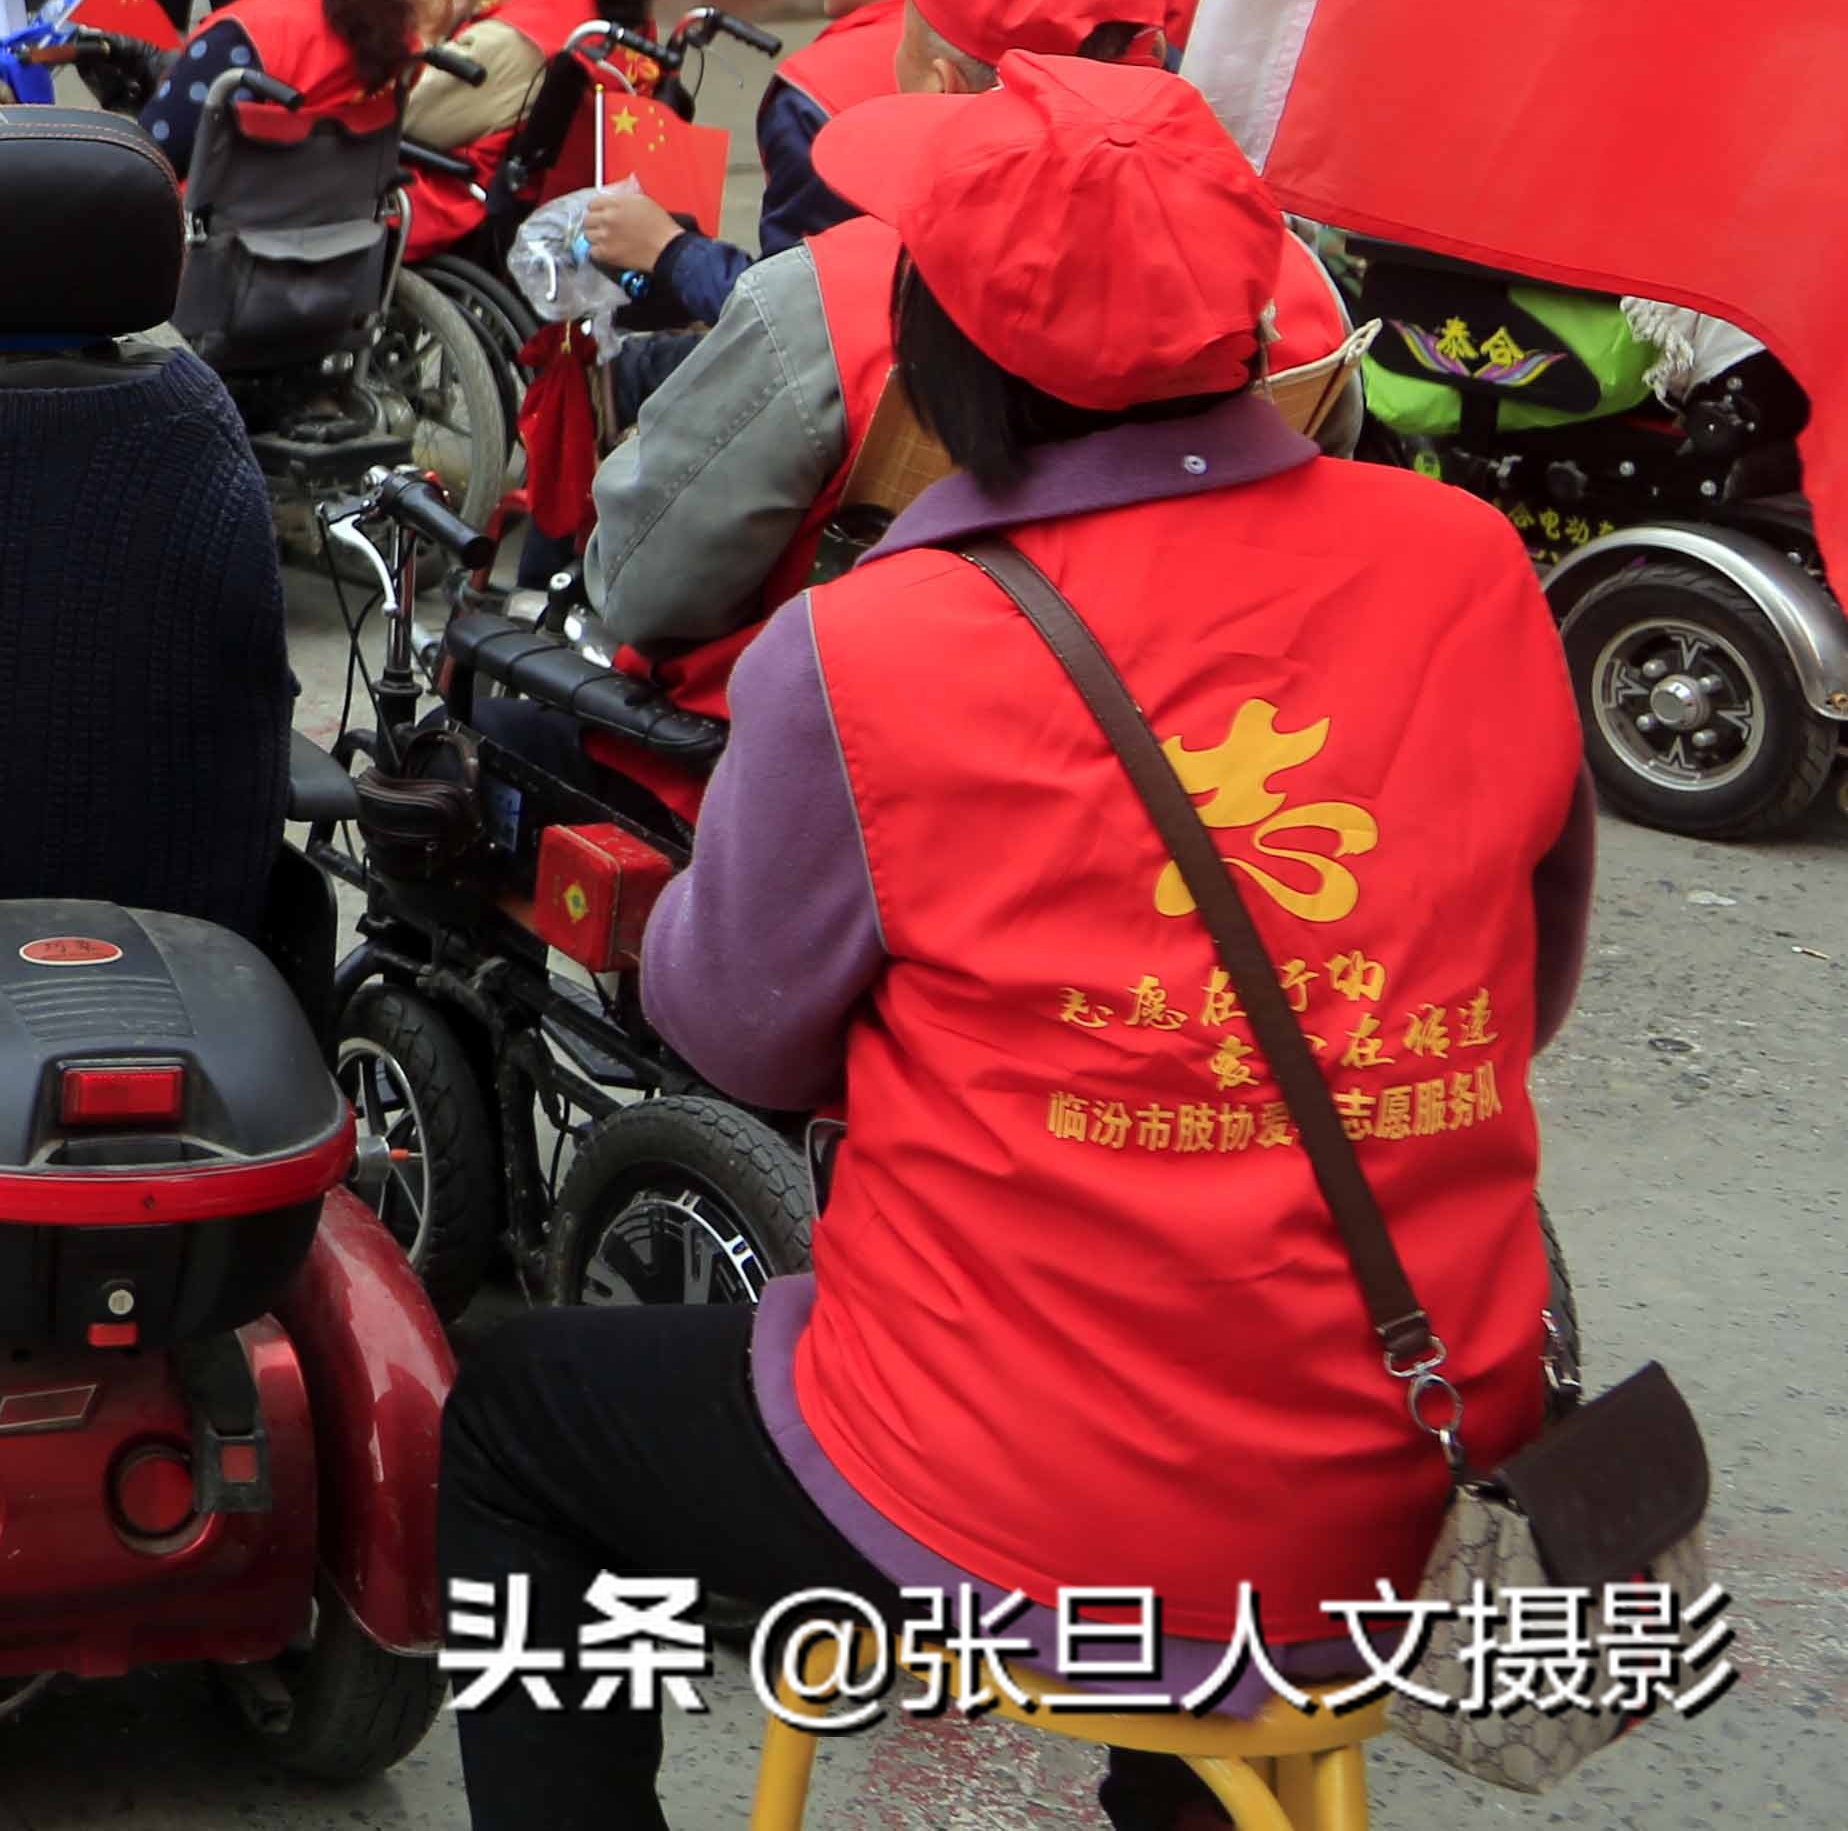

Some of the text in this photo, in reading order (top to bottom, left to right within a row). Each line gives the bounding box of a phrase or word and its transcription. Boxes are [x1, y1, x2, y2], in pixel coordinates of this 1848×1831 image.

[1047, 1059, 1503, 1153] 临汾市肢协爱志愿服务队
